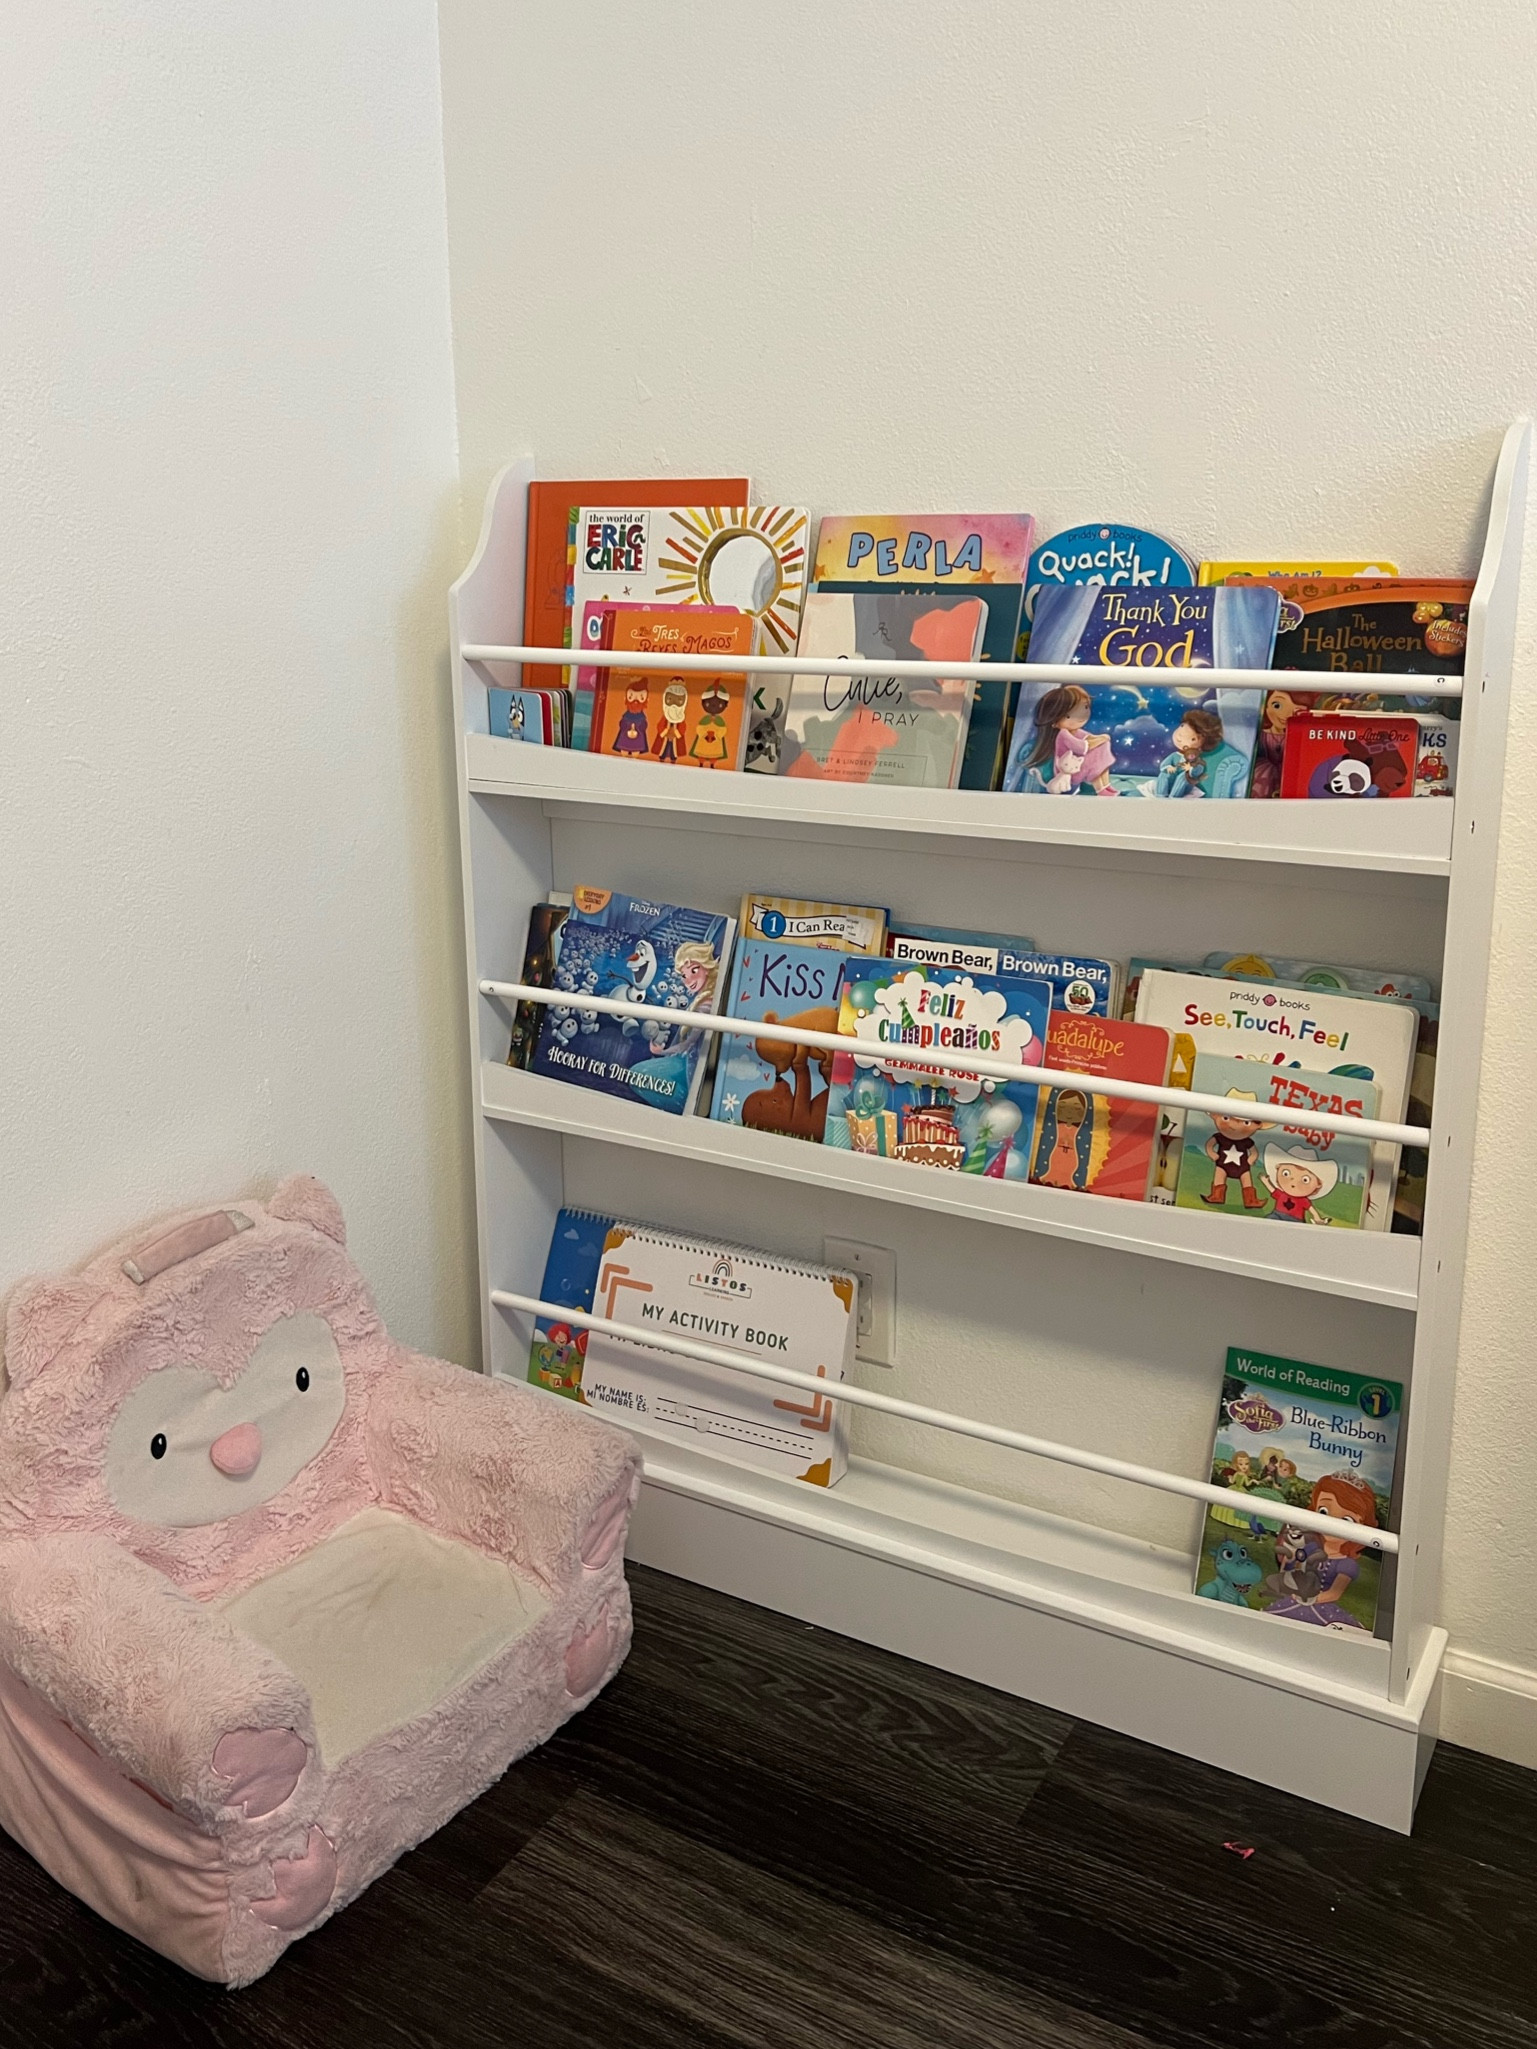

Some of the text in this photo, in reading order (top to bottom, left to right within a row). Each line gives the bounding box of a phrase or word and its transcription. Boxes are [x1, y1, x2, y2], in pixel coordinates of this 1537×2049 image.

[589, 513, 646, 524] the world of
[1067, 529, 1144, 543] priddy books
[585, 546, 644, 572] CARLE
[846, 530, 983, 577] PERLA
[1038, 541, 1136, 584] Quack!
[1101, 593, 1208, 628] Thank You
[1352, 613, 1377, 632] The
[1099, 624, 1196, 669] God
[1301, 626, 1424, 654] Halloween
[1428, 629, 1466, 648] Stickers
[1329, 652, 1384, 674] Ball
[871, 711, 920, 727] PRAY
[1308, 729, 1324, 740] BE
[1326, 729, 1357, 741] KIND
[1422, 732, 1448, 748] KS
[629, 902, 661, 917] FROZEN
[769, 916, 778, 933] 1
[796, 920, 821, 933] Can
[823, 918, 846, 932] Rea
[897, 943, 949, 964] Brown
[951, 949, 994, 972] Bear,
[1002, 955, 1108, 984] Brown Bear,
[917, 989, 967, 1021] Feliz
[1229, 991, 1312, 1011] priddy books
[878, 1018, 1001, 1052] Cumpleaños
[1184, 1003, 1350, 1051] See, Touch, Feel
[1046, 1026, 1125, 1059] uadalupe
[547, 1045, 676, 1096] HOORAY FOR DIFFERENCES!
[1268, 1075, 1364, 1119] TEXAS
[695, 1272, 747, 1292] LISTOS
[641, 1303, 789, 1352] MY ACTIVITY BOOK
[1236, 1357, 1351, 1396] World of Reading
[586, 1389, 597, 1399] MI
[599, 1392, 634, 1409] NOMBRE
[594, 1383, 607, 1393] MY
[608, 1386, 633, 1401] NAME
[1371, 1393, 1381, 1416] 1
[1234, 1401, 1275, 1422] Sofia
[1290, 1405, 1387, 1444] Blue-Ribbon
[1308, 1431, 1364, 1468] Bunny
